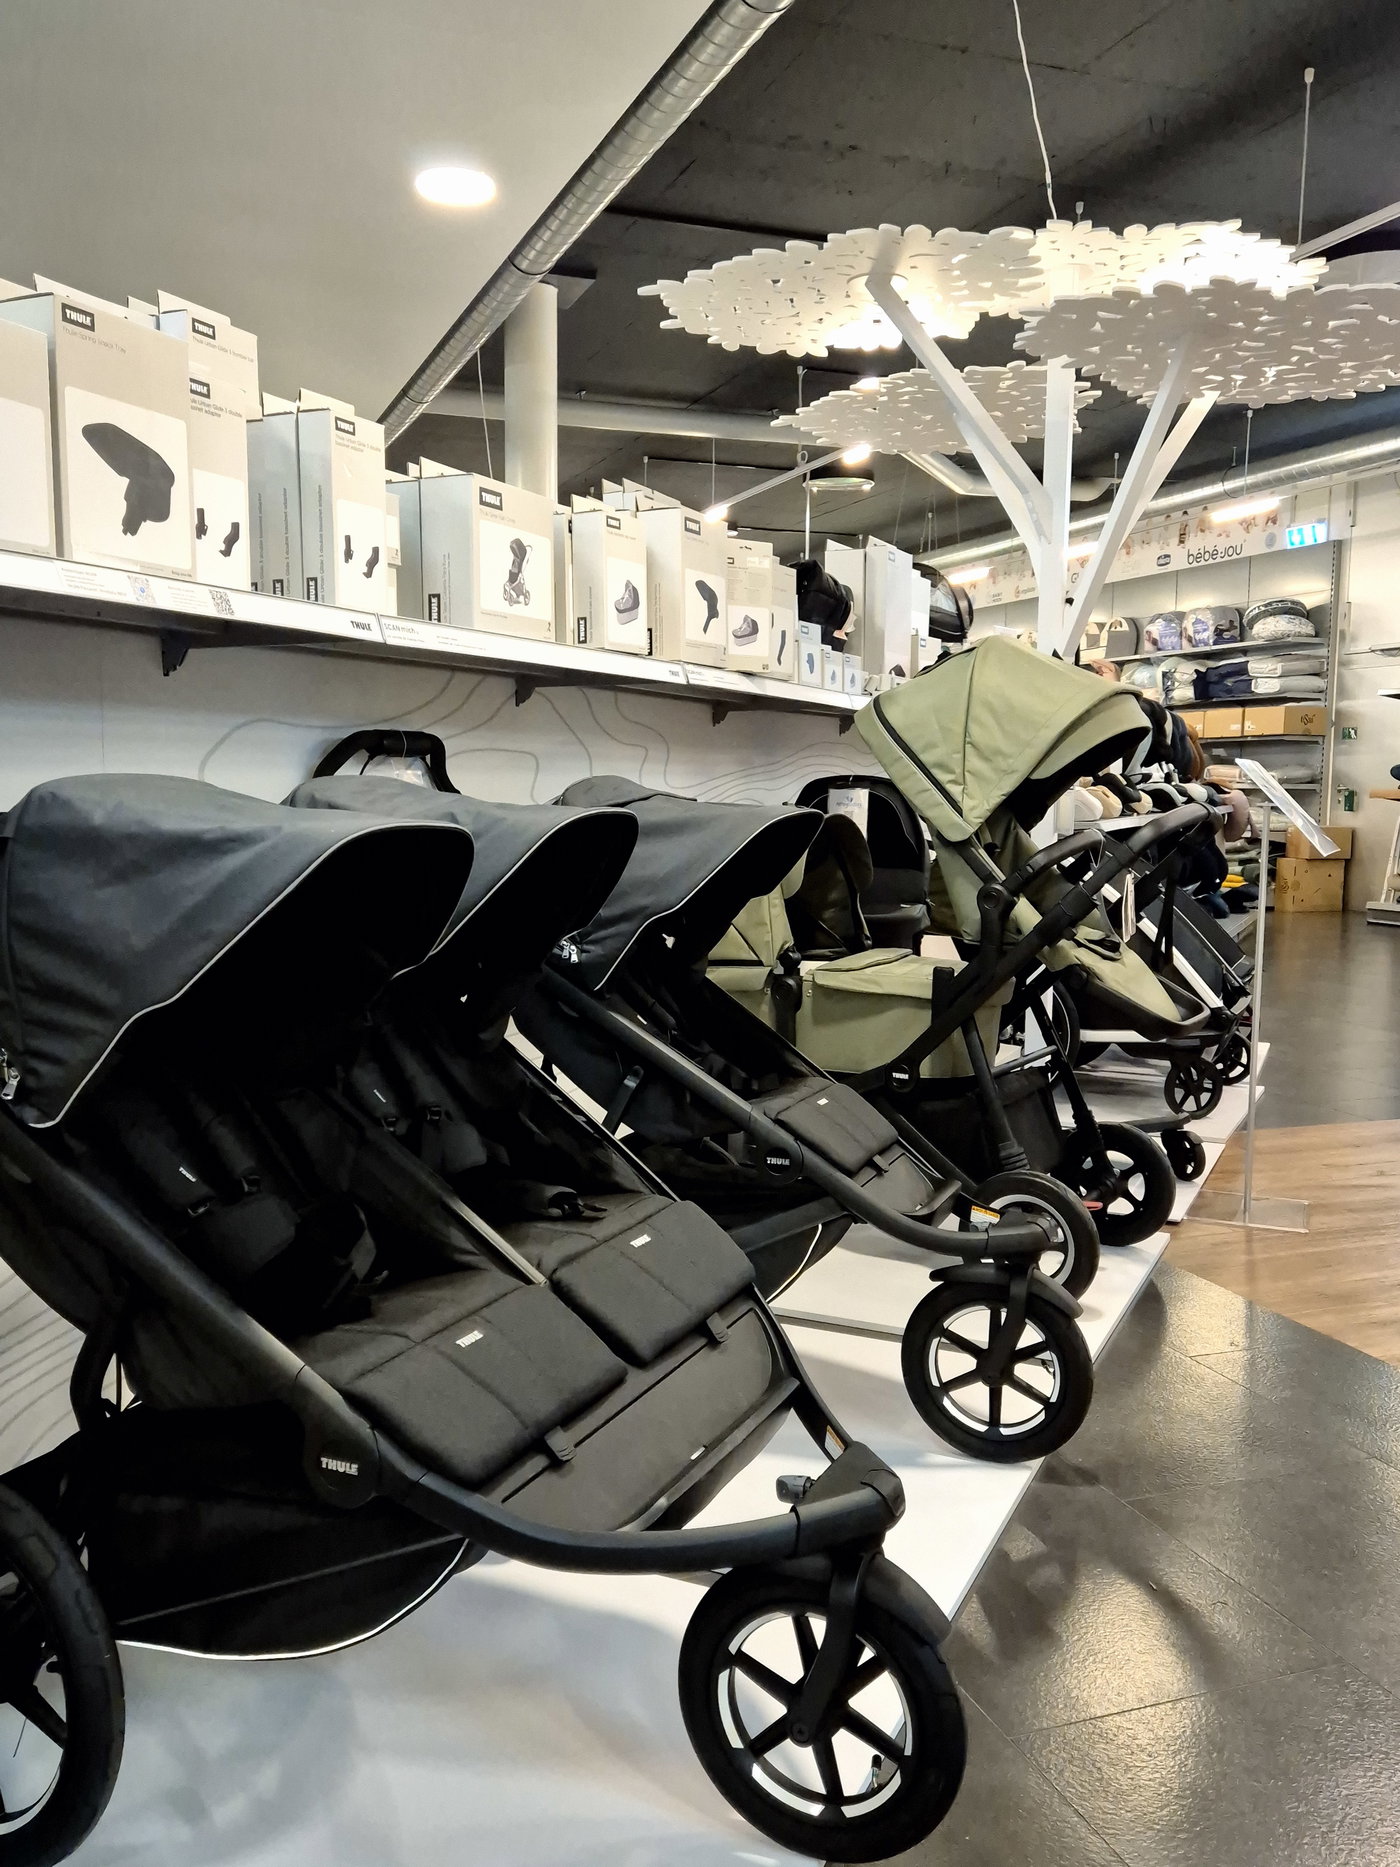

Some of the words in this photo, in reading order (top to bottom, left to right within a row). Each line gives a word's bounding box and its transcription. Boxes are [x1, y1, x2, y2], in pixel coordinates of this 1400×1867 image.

[65, 308, 92, 326] THULE
[194, 322, 214, 336] THULE
[481, 492, 501, 506] THULE
[350, 620, 373, 632] THULE
[766, 1156, 790, 1166] THULE
[455, 1330, 484, 1348] THULE
[320, 1457, 359, 1476] THULE
